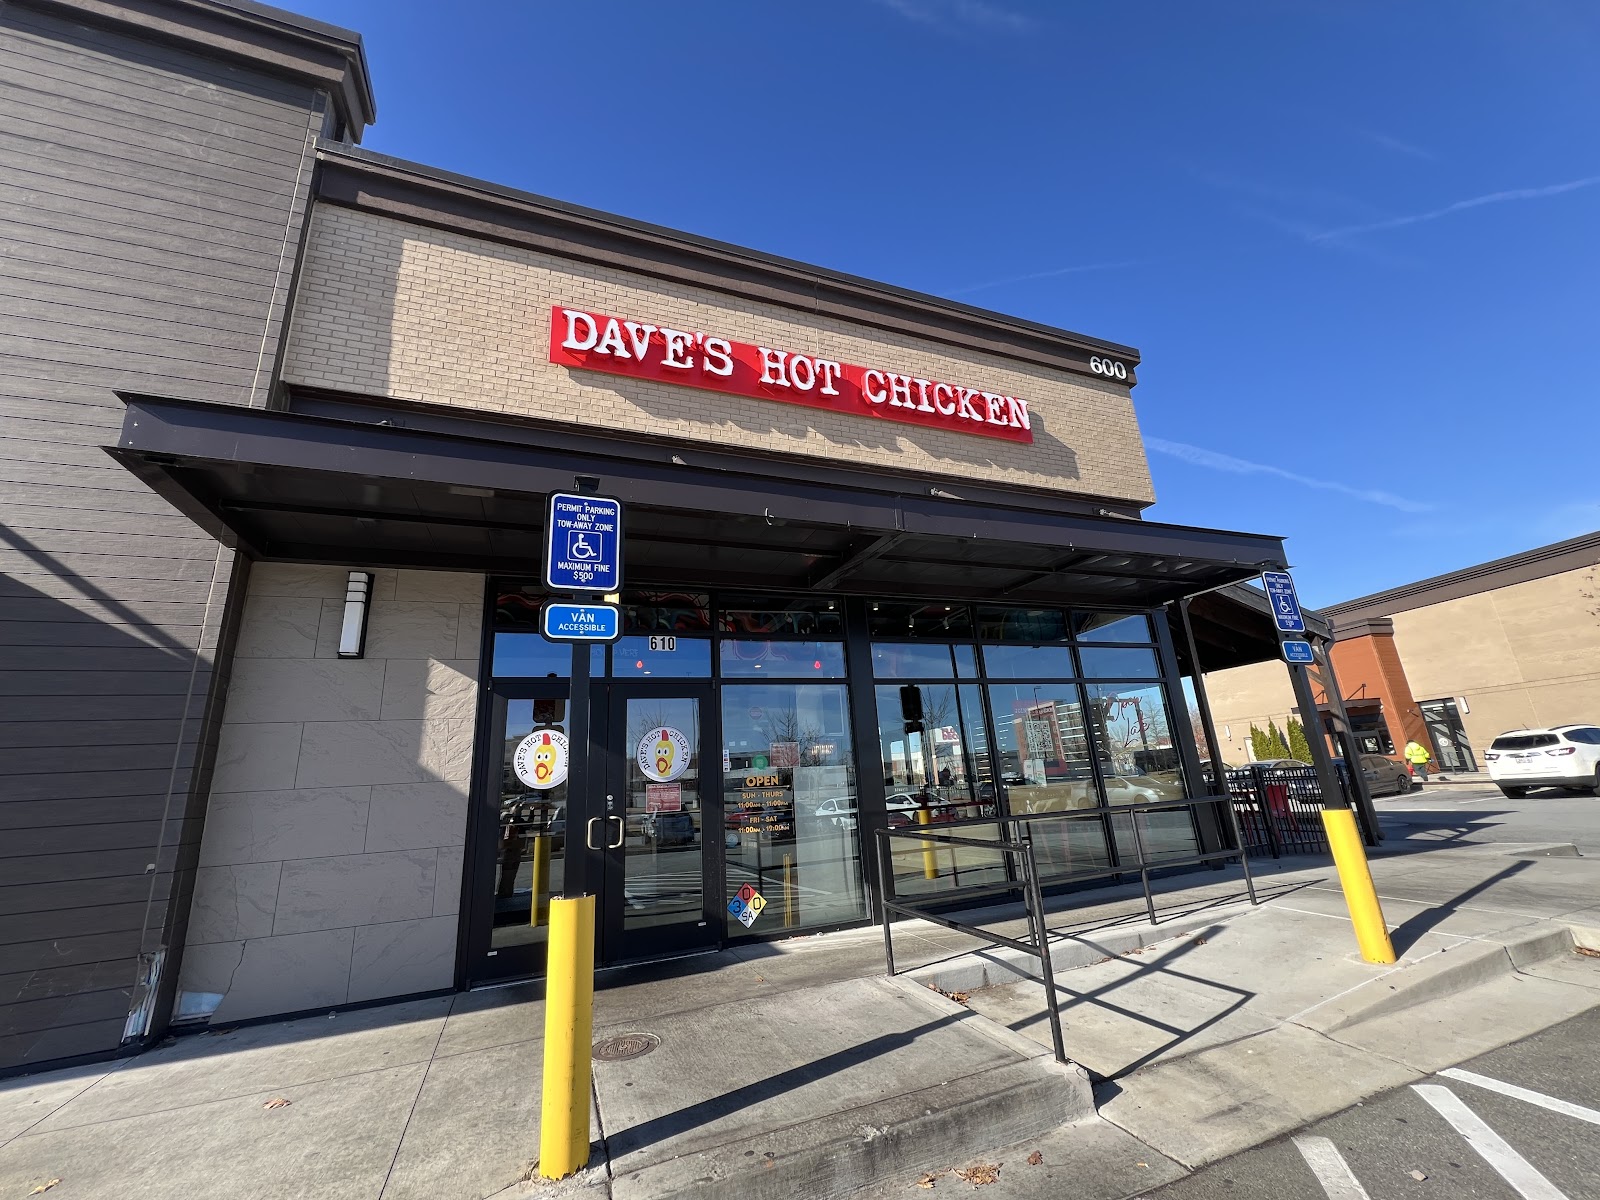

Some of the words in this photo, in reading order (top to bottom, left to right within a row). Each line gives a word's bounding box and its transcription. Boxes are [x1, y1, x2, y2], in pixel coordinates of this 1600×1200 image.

[561, 309, 734, 376] DAVE'S
[757, 347, 841, 396] HOT
[861, 369, 1031, 430] CHICKEN
[1090, 356, 1127, 379] 600
[557, 503, 582, 513] PERMIT
[585, 505, 615, 516] PARKING
[576, 513, 596, 522] ONLY
[557, 520, 592, 530] TOW-AWAY
[594, 523, 614, 532] ZONE
[557, 561, 592, 572] MAXIMUM
[594, 564, 610, 573] FINE
[573, 571, 594, 581] $500
[571, 612, 595, 623] VAN
[558, 623, 606, 632] ACCESSIBLE
[650, 636, 675, 651] 610
[1291, 645, 1303, 653] VAN
[517, 747, 529, 777] DAVE'S
[524, 733, 542, 748] HOT
[640, 742, 651, 770] DAVE'S
[646, 730, 661, 743] HOT
[669, 730, 689, 764] CHICKEN
[746, 776, 779, 787] OPEN
[742, 887, 751, 901] 0
[732, 900, 742, 914] 3
[752, 897, 762, 910] 0
[741, 911, 754, 922] SA
